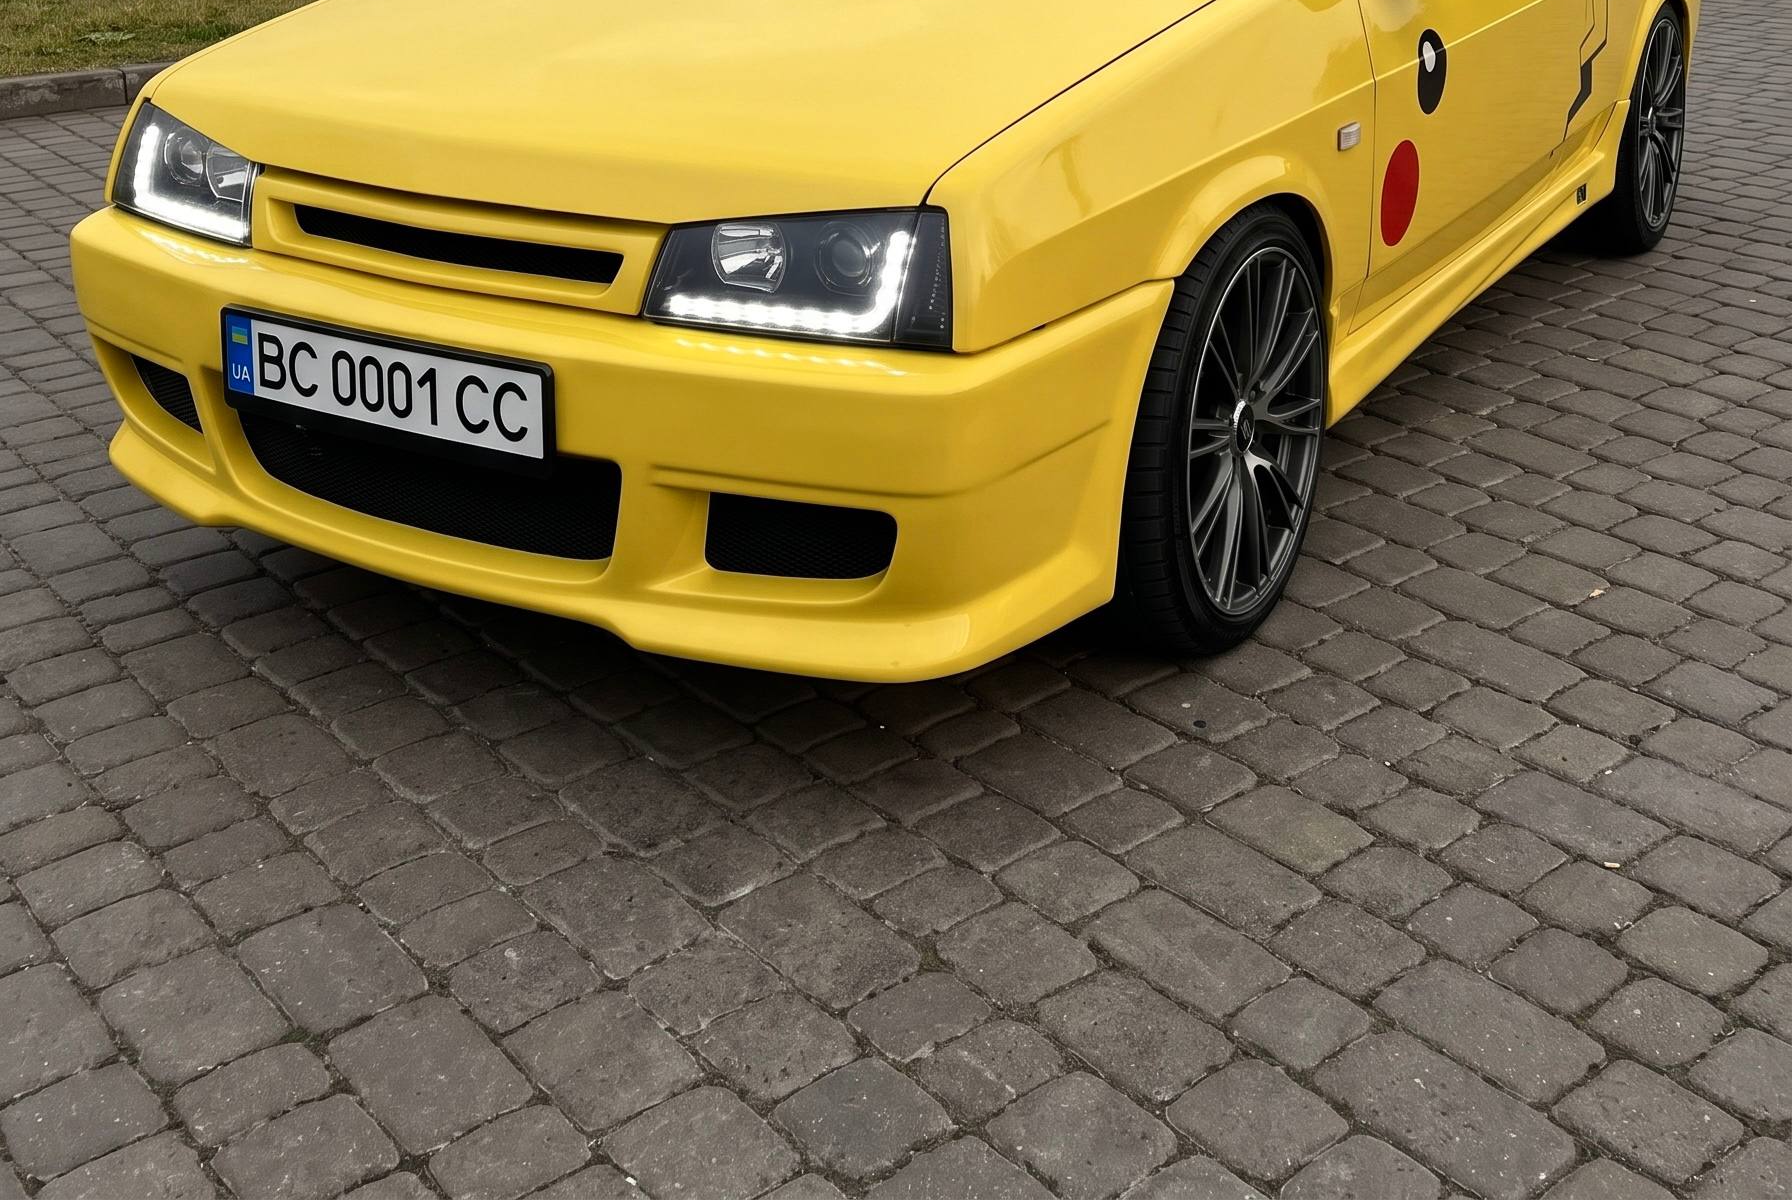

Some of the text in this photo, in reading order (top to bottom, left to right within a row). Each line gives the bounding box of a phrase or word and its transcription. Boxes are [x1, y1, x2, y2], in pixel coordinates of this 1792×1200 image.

[232, 363, 251, 383] UA
[257, 332, 529, 442] BC 0001 CC
